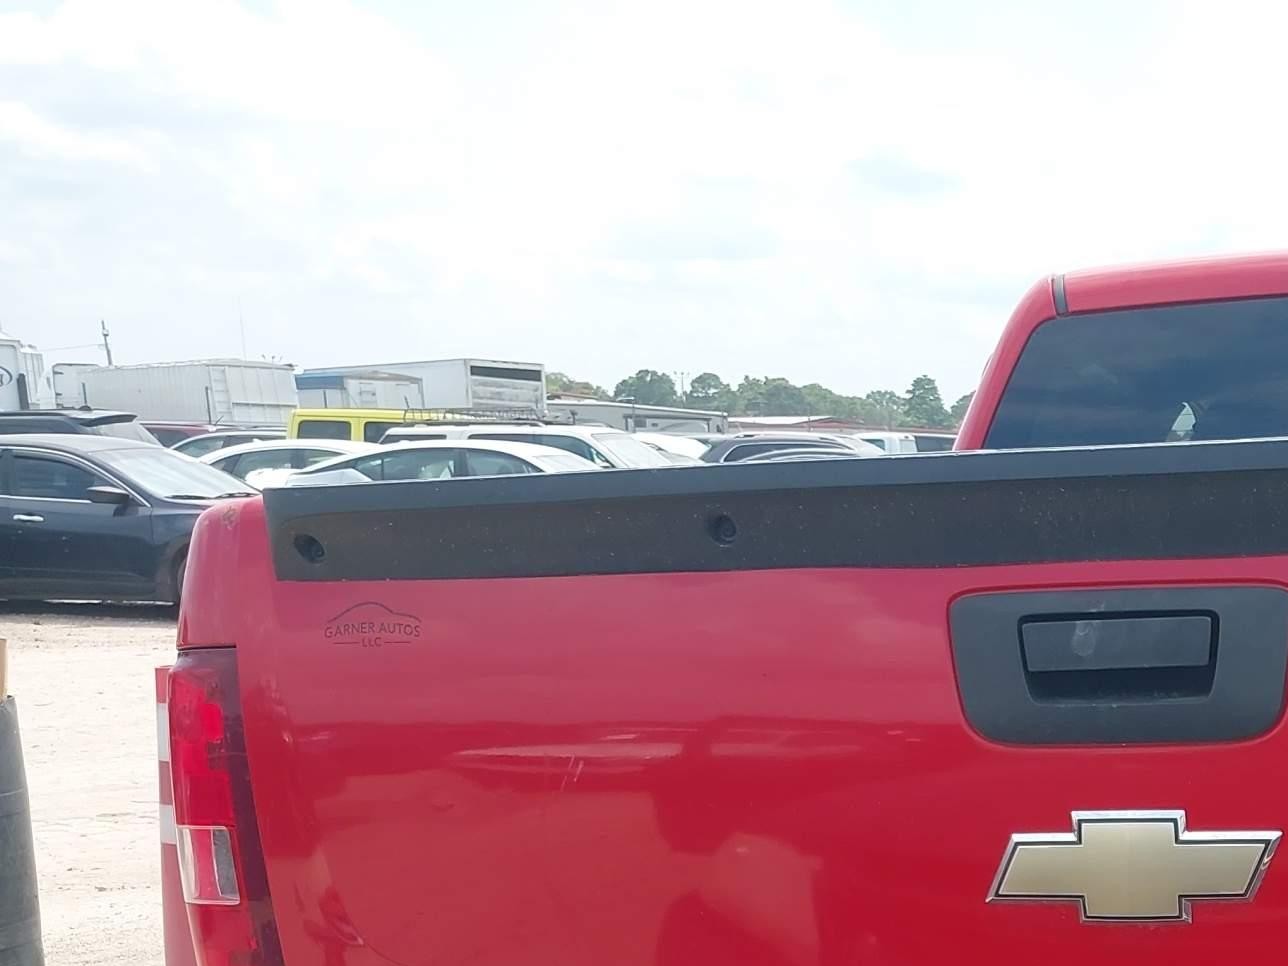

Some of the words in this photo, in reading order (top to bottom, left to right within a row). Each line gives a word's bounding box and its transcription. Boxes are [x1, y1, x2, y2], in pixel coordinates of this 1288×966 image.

[324, 622, 375, 638] GARNER
[379, 622, 421, 637] AUTOS
[361, 637, 382, 648] LLC
